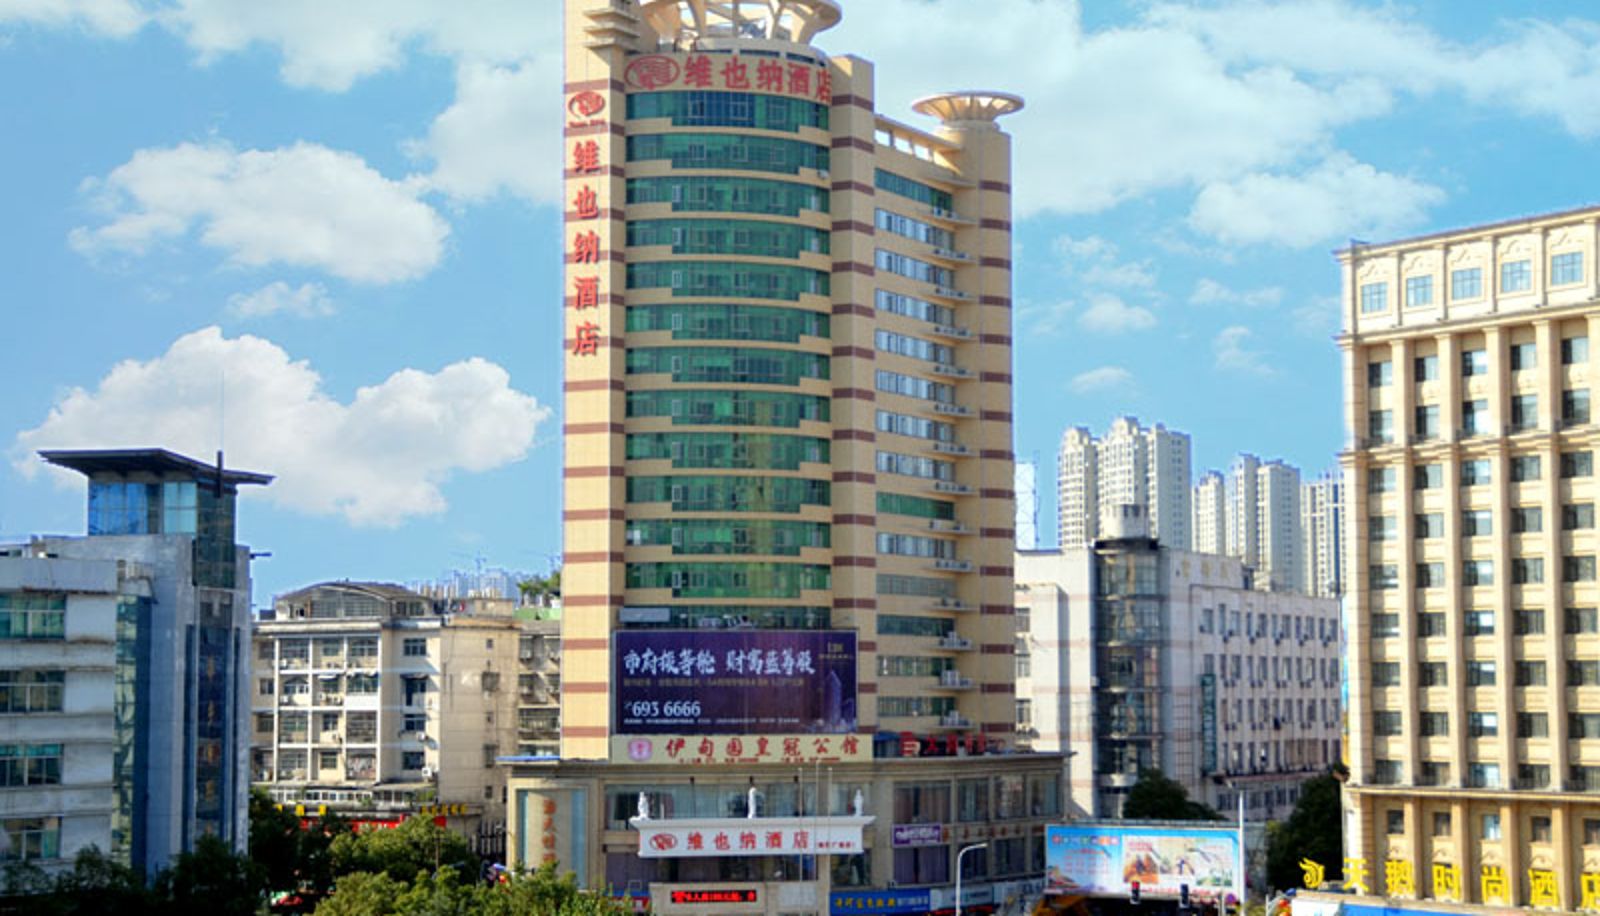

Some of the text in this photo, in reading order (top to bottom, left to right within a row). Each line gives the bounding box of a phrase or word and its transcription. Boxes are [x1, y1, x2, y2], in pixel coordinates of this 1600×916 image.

[683, 54, 832, 102] 维也纳酒店
[572, 138, 601, 356] 维也纳酒店
[632, 700, 701, 717] 693 6666
[685, 830, 810, 850] 维也纳酒店
